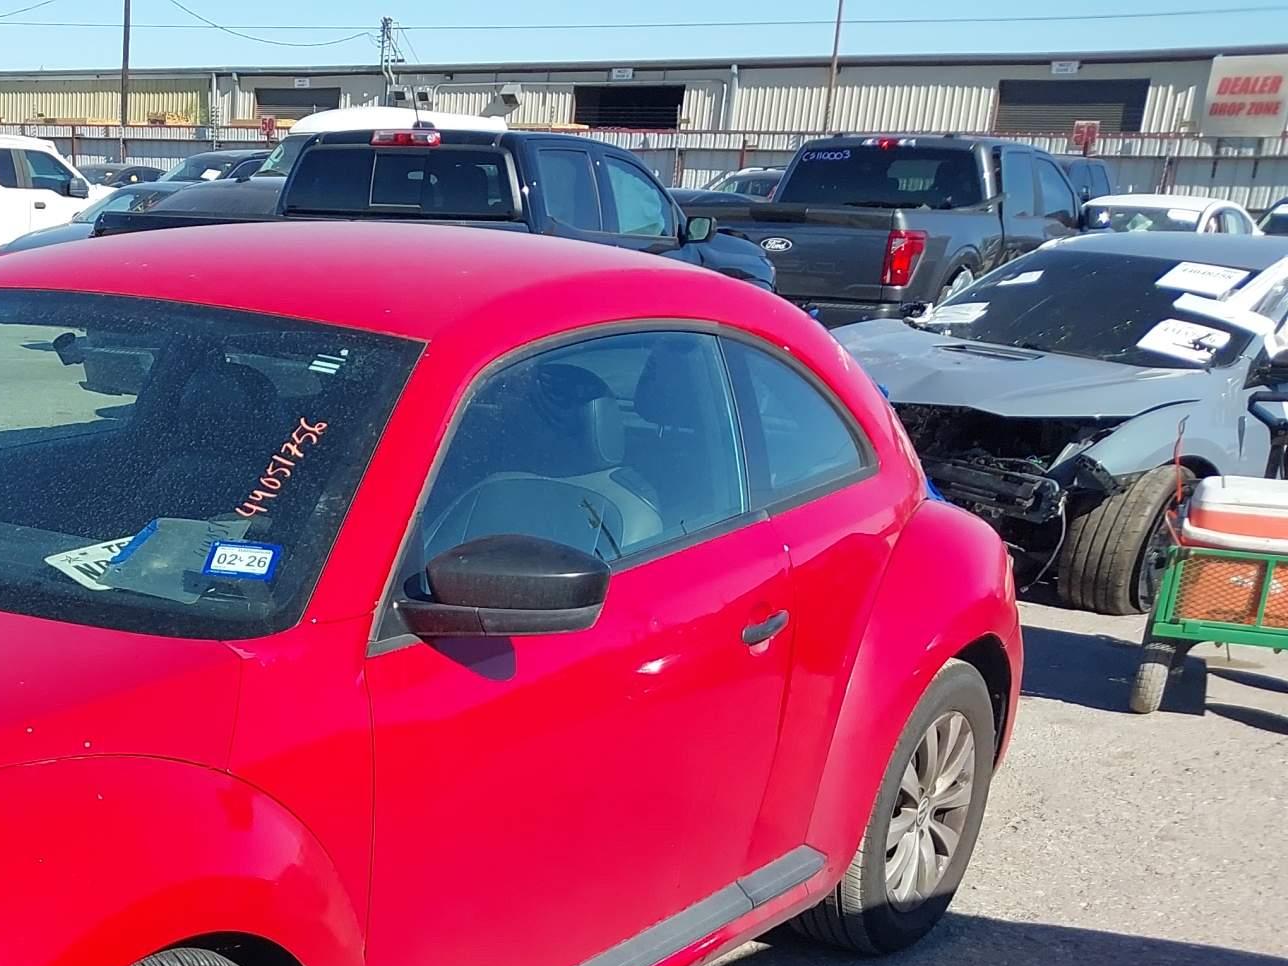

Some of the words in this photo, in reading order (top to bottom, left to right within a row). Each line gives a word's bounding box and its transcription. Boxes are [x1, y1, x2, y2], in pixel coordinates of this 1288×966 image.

[1216, 76, 1283, 96] DEALER
[1209, 102, 1245, 116] DROP
[1246, 101, 1281, 116] ZONE
[234, 416, 328, 518] 44051756
